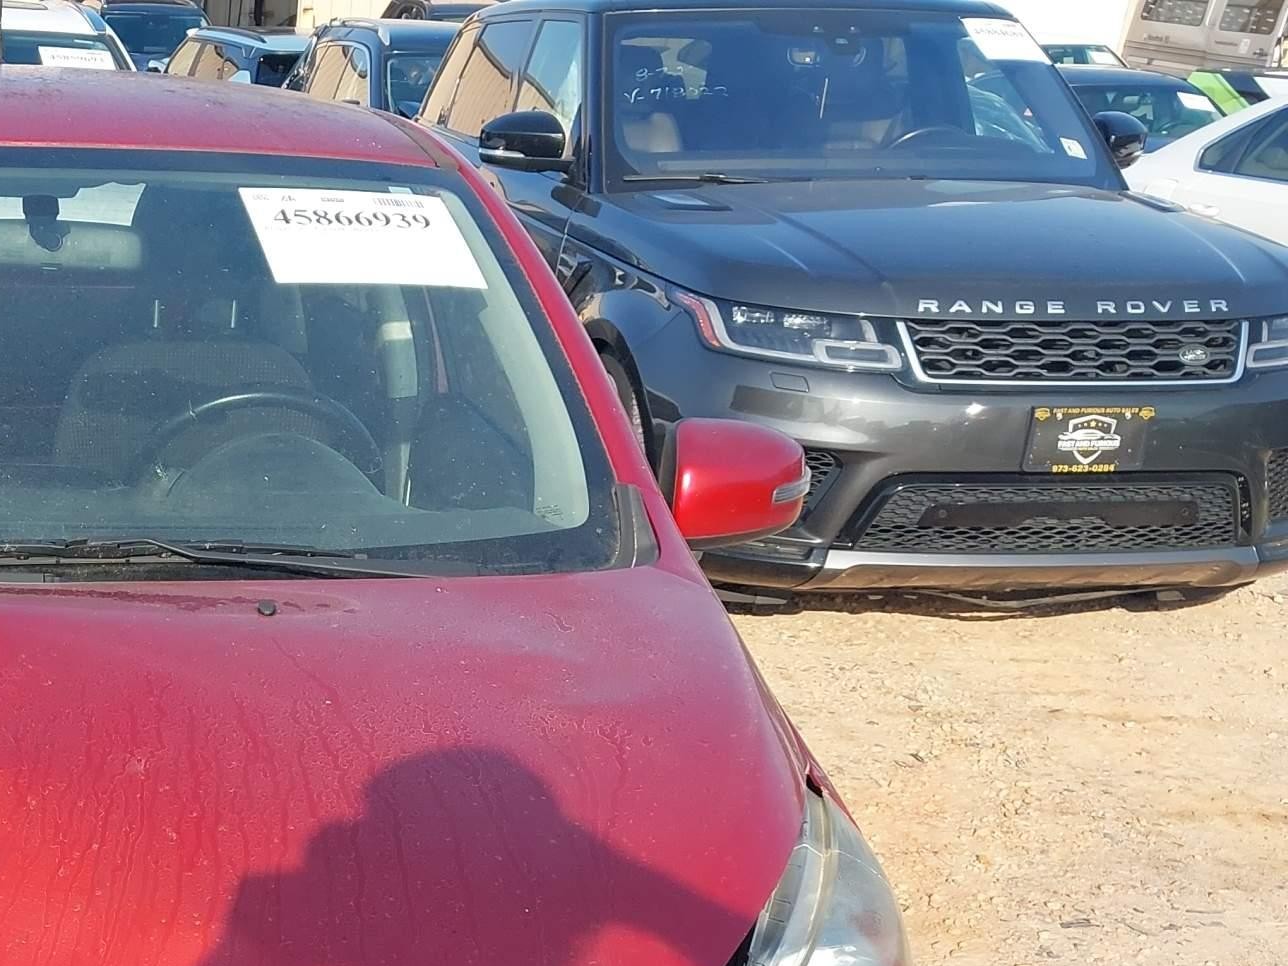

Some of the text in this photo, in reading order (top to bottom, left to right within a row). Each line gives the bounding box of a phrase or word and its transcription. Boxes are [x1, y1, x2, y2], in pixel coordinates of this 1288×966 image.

[273, 208, 431, 230] 45866939
[918, 299, 1230, 315] RANGE ROVER
